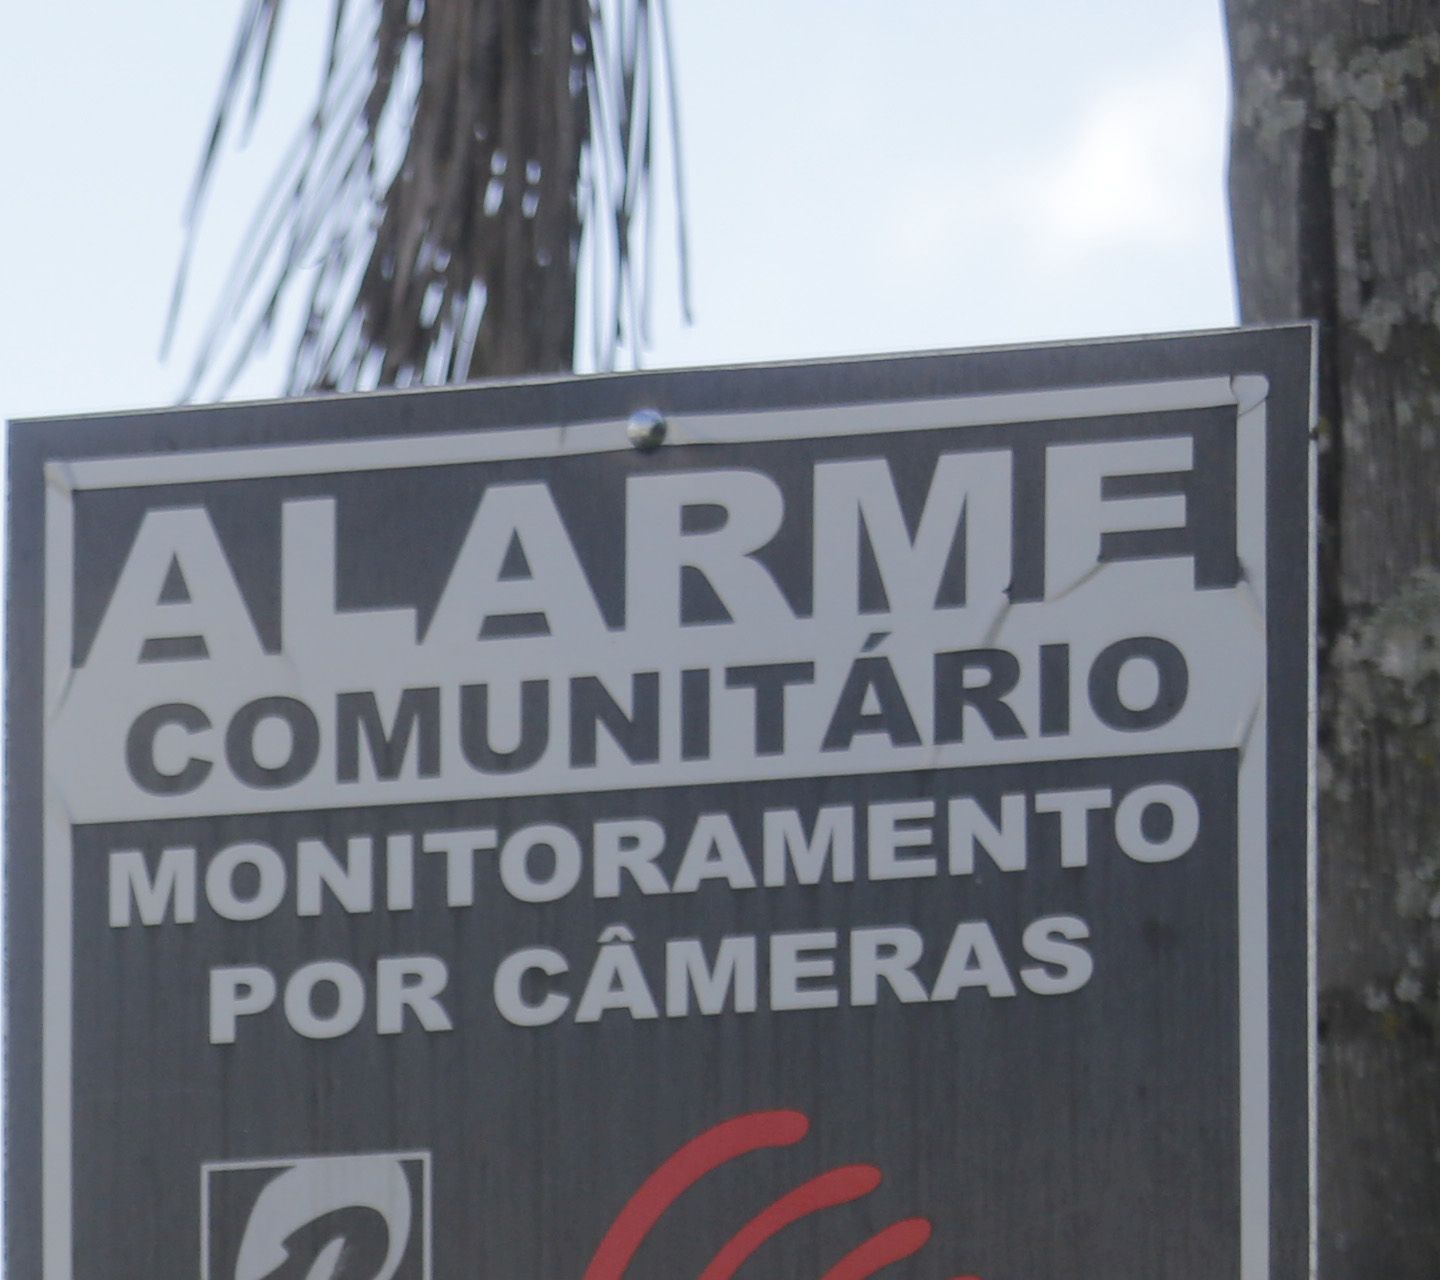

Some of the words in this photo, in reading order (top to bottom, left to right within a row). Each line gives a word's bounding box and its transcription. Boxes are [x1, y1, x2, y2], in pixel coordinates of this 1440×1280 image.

[80, 435, 1198, 672] ALARME
[124, 633, 1191, 797] COMUNITÁRIO
[105, 781, 1202, 930] MONITORAMENTO
[207, 955, 455, 1046] POR
[492, 914, 1094, 1028] CÂMERAS
